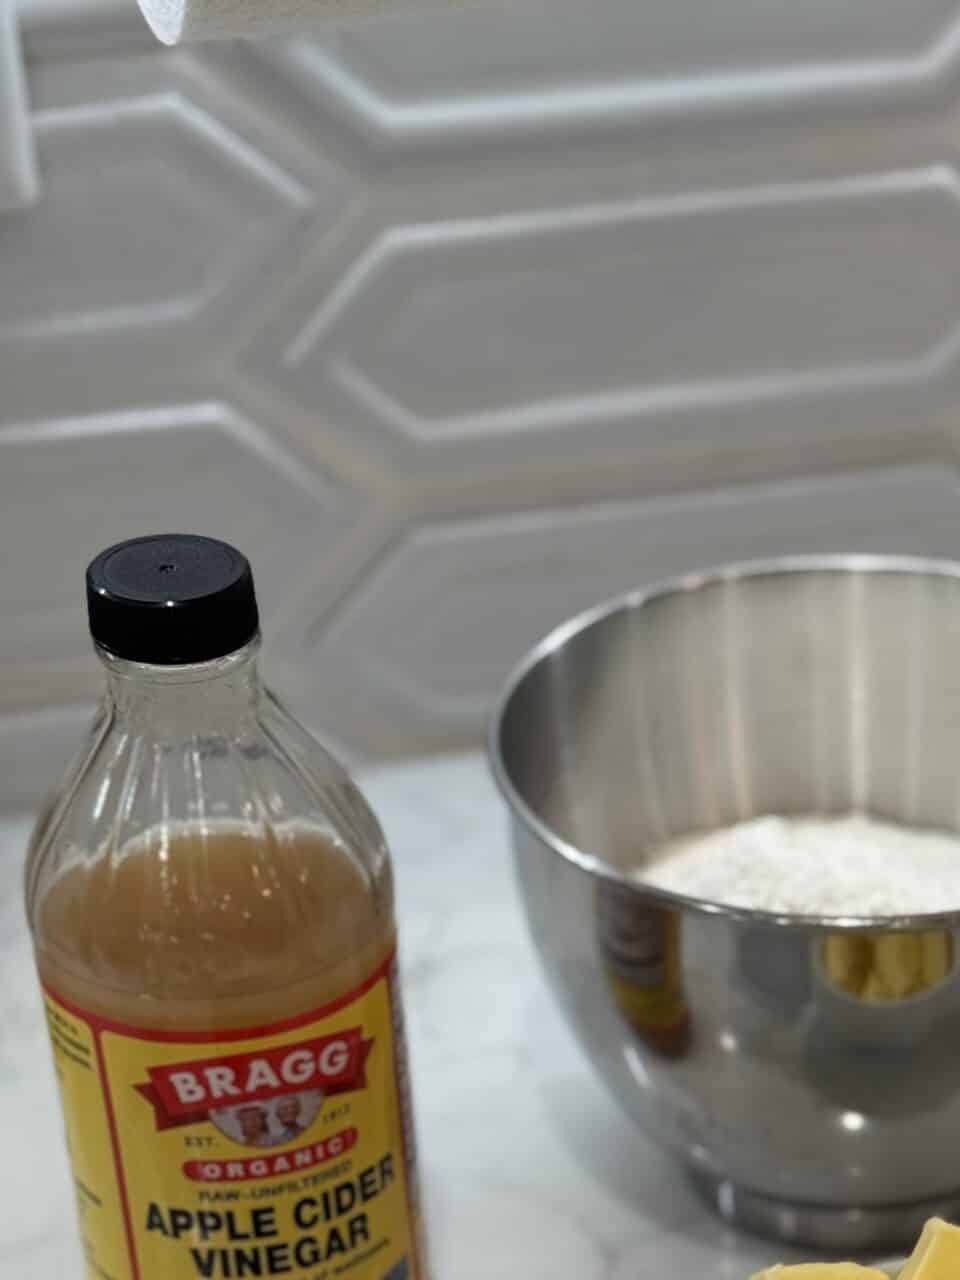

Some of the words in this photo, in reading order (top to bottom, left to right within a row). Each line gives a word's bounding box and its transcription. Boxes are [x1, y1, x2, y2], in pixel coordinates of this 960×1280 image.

[169, 1040, 350, 1105] BRAGG
[201, 1137, 344, 1178] ORGANIC
[146, 1202, 278, 1240] APPLE
[293, 1152, 396, 1230] CIDER
[190, 1213, 370, 1278] VINEGAR
